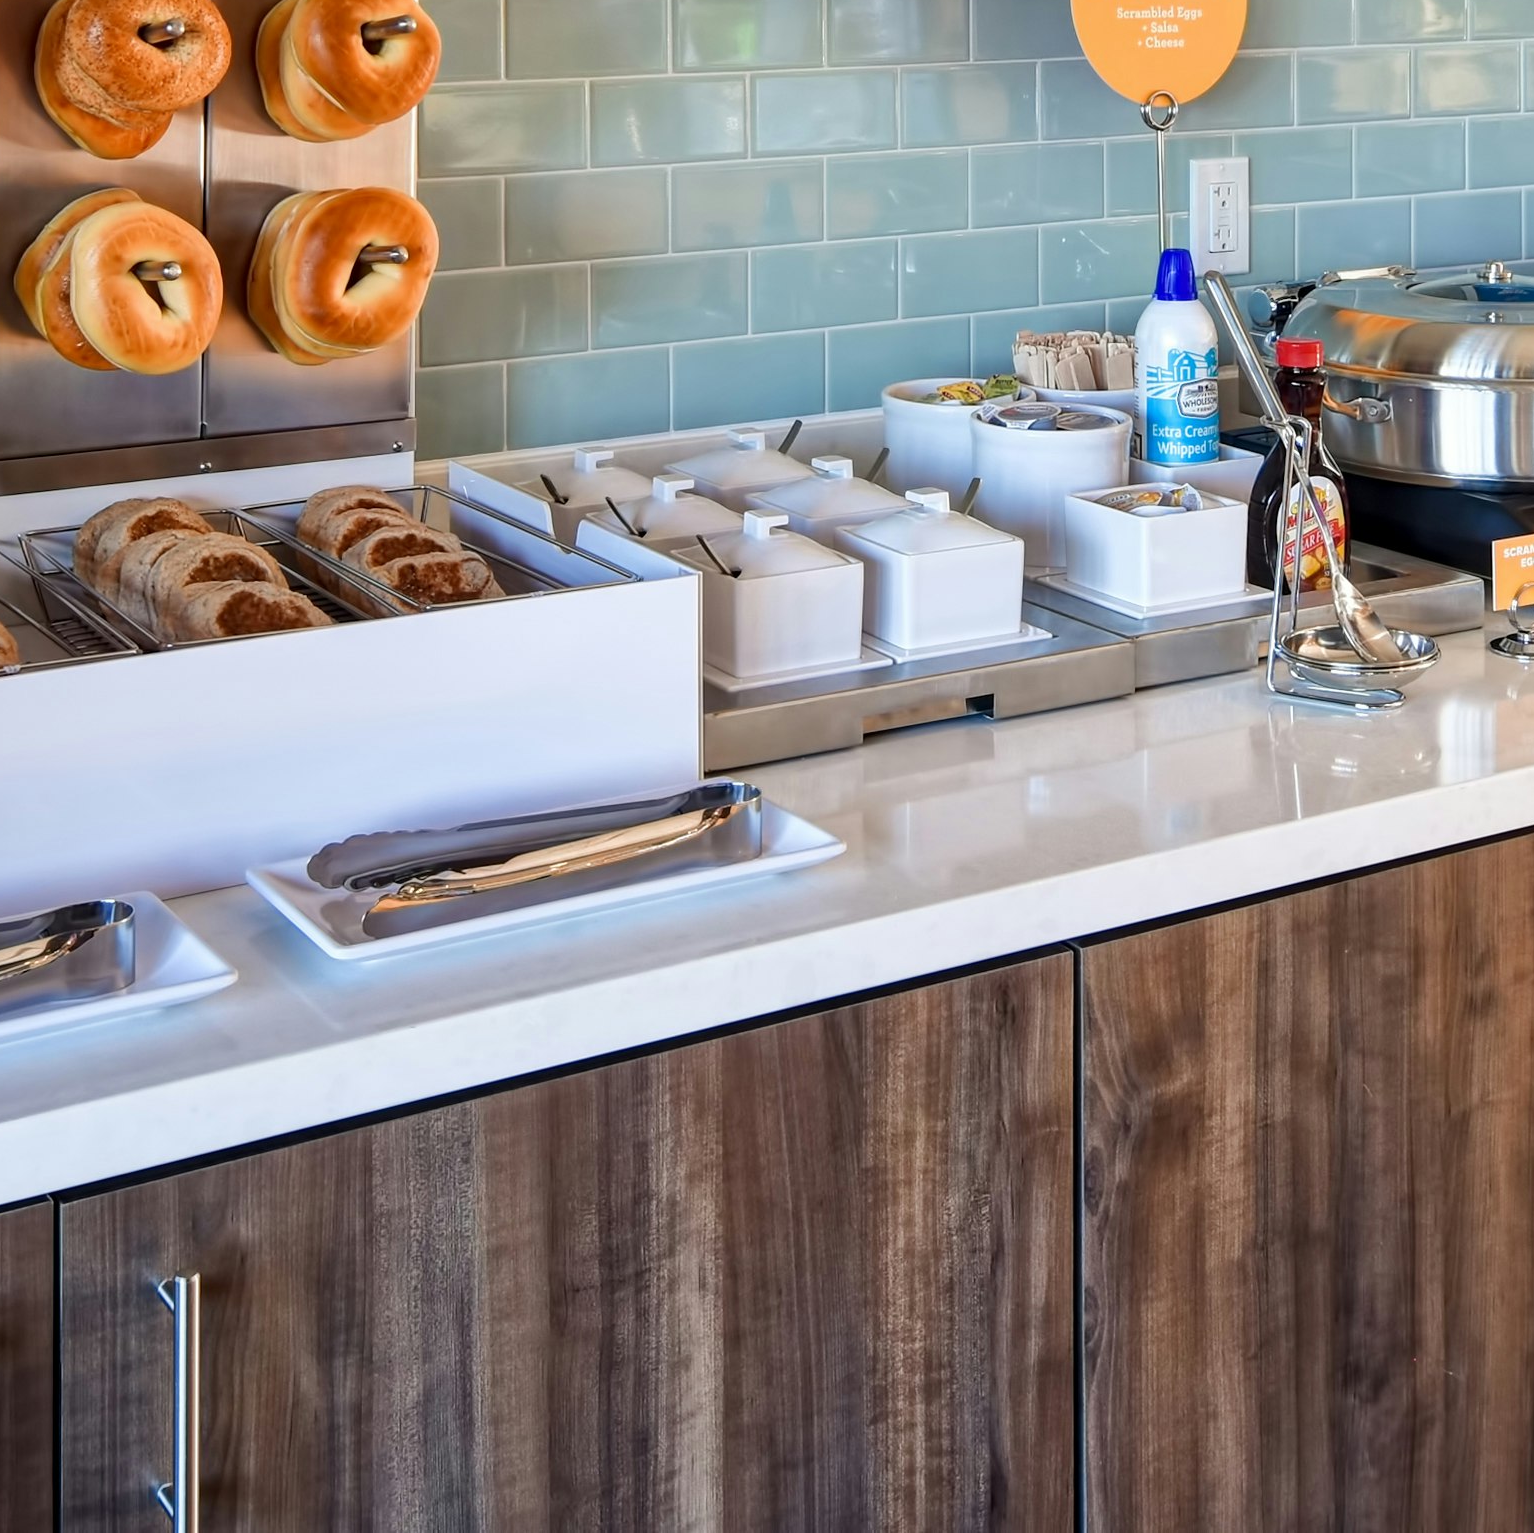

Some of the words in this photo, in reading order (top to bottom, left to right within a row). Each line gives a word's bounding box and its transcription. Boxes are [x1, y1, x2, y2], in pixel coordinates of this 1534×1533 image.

[1116, 7, 1174, 19] Scrambled
[1177, 7, 1202, 20] Eggs
[1150, 21, 1178, 33] Salsa
[1145, 36, 1185, 48] Cheese
[1152, 424, 1182, 438] Extra
[1157, 439, 1206, 459] Whipped
[1286, 534, 1316, 559] SUAR
